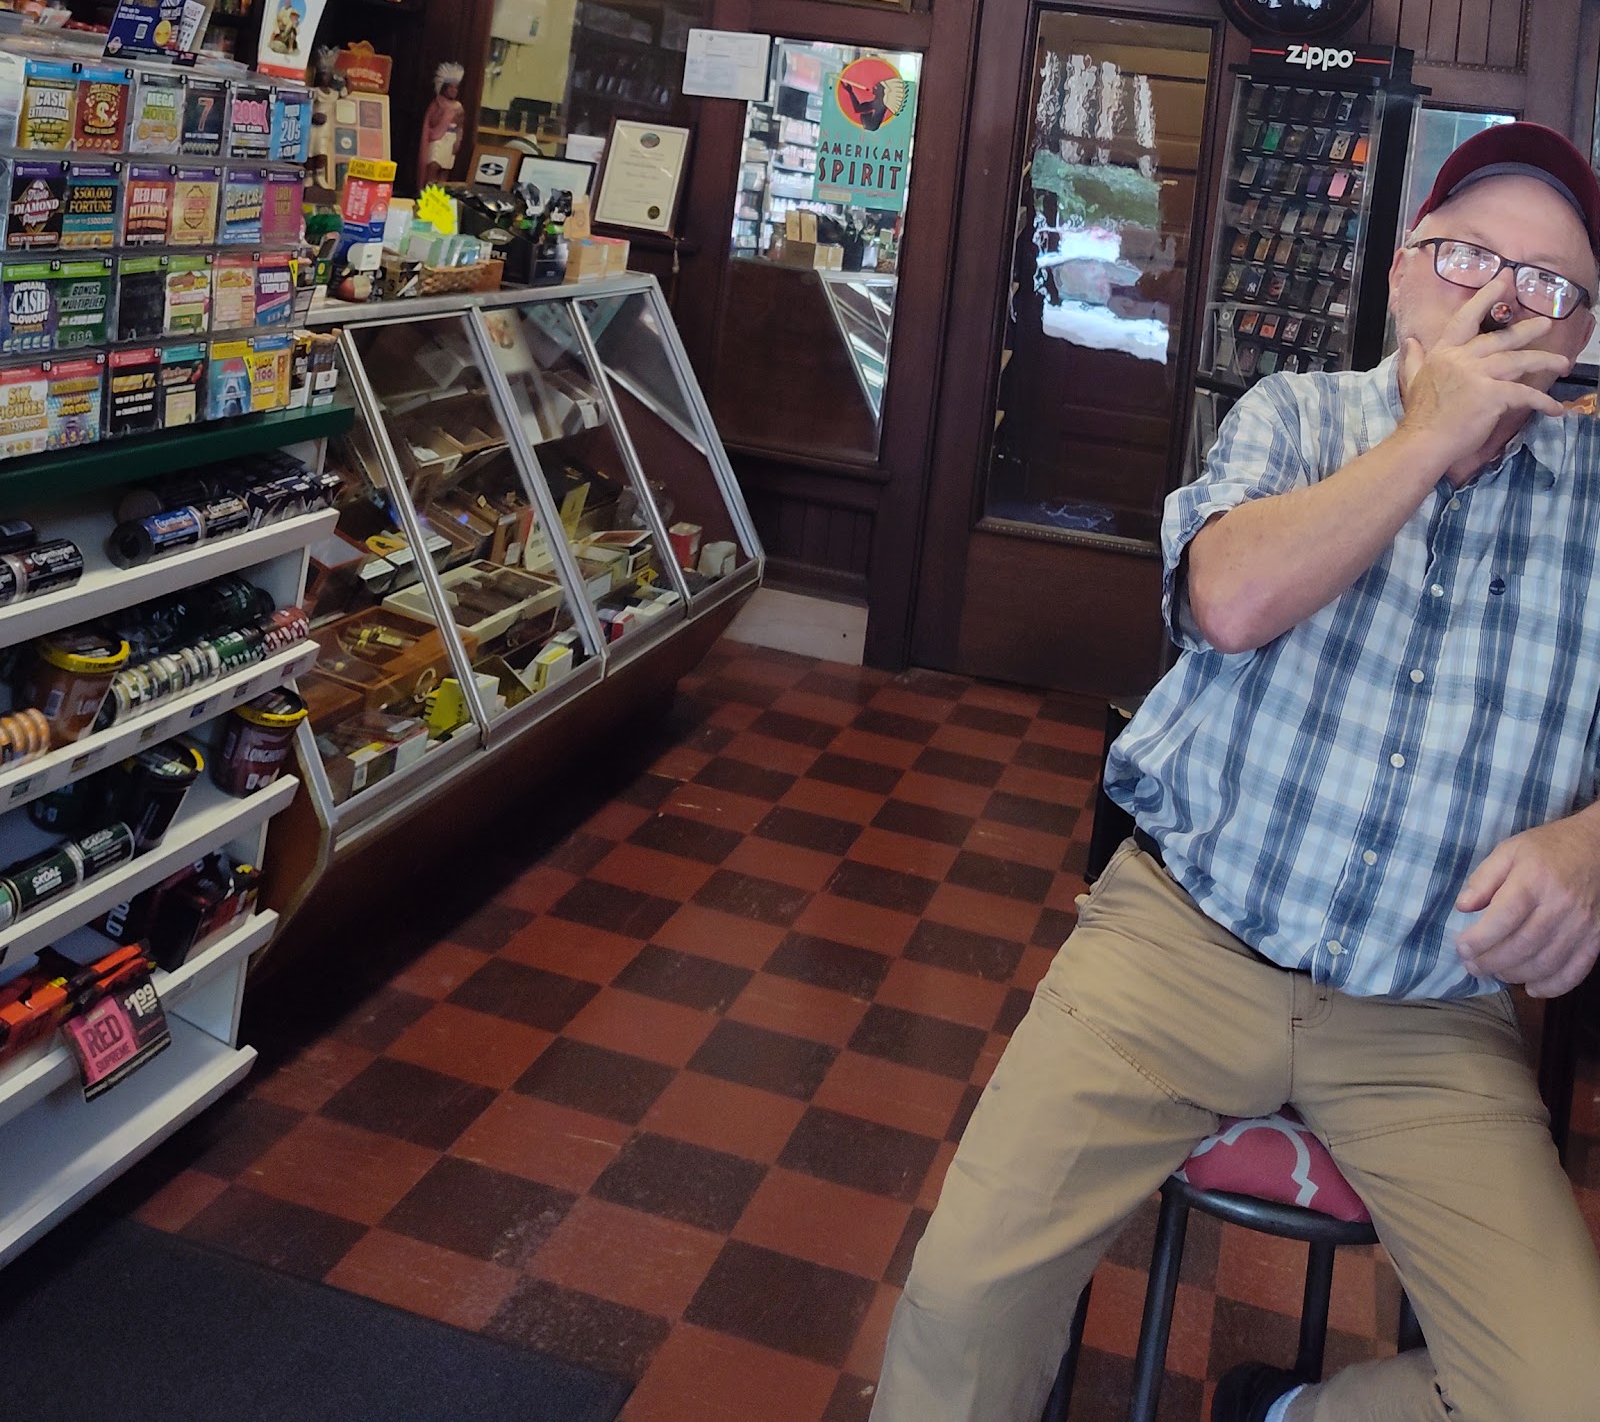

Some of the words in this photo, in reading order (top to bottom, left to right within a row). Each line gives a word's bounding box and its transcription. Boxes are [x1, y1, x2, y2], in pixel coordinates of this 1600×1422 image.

[36, 91, 66, 107] CASH
[147, 92, 174, 107] MEGA
[820, 141, 904, 162] AMERICAN
[819, 156, 902, 190] SPIRIT
[74, 187, 112, 199] $500,000
[14, 198, 59, 216] DIAMOND
[69, 200, 112, 213] FORTUNE
[52, 260, 60, 270] 13
[104, 258, 113, 268] 14
[14, 281, 46, 293] INDIANA
[72, 284, 100, 297] BONUS
[12, 290, 47, 315] CASH
[61, 296, 106, 311] MULTIPLIER
[9, 312, 49, 325] BLOWOUT
[43, 361, 51, 371] 19
[96, 354, 105, 364] 20
[7, 385, 33, 405] SIX
[32, 865, 62, 889] SKOAL
[81, 1014, 124, 1058] RED
[95, 1041, 132, 1074] SUPREME
